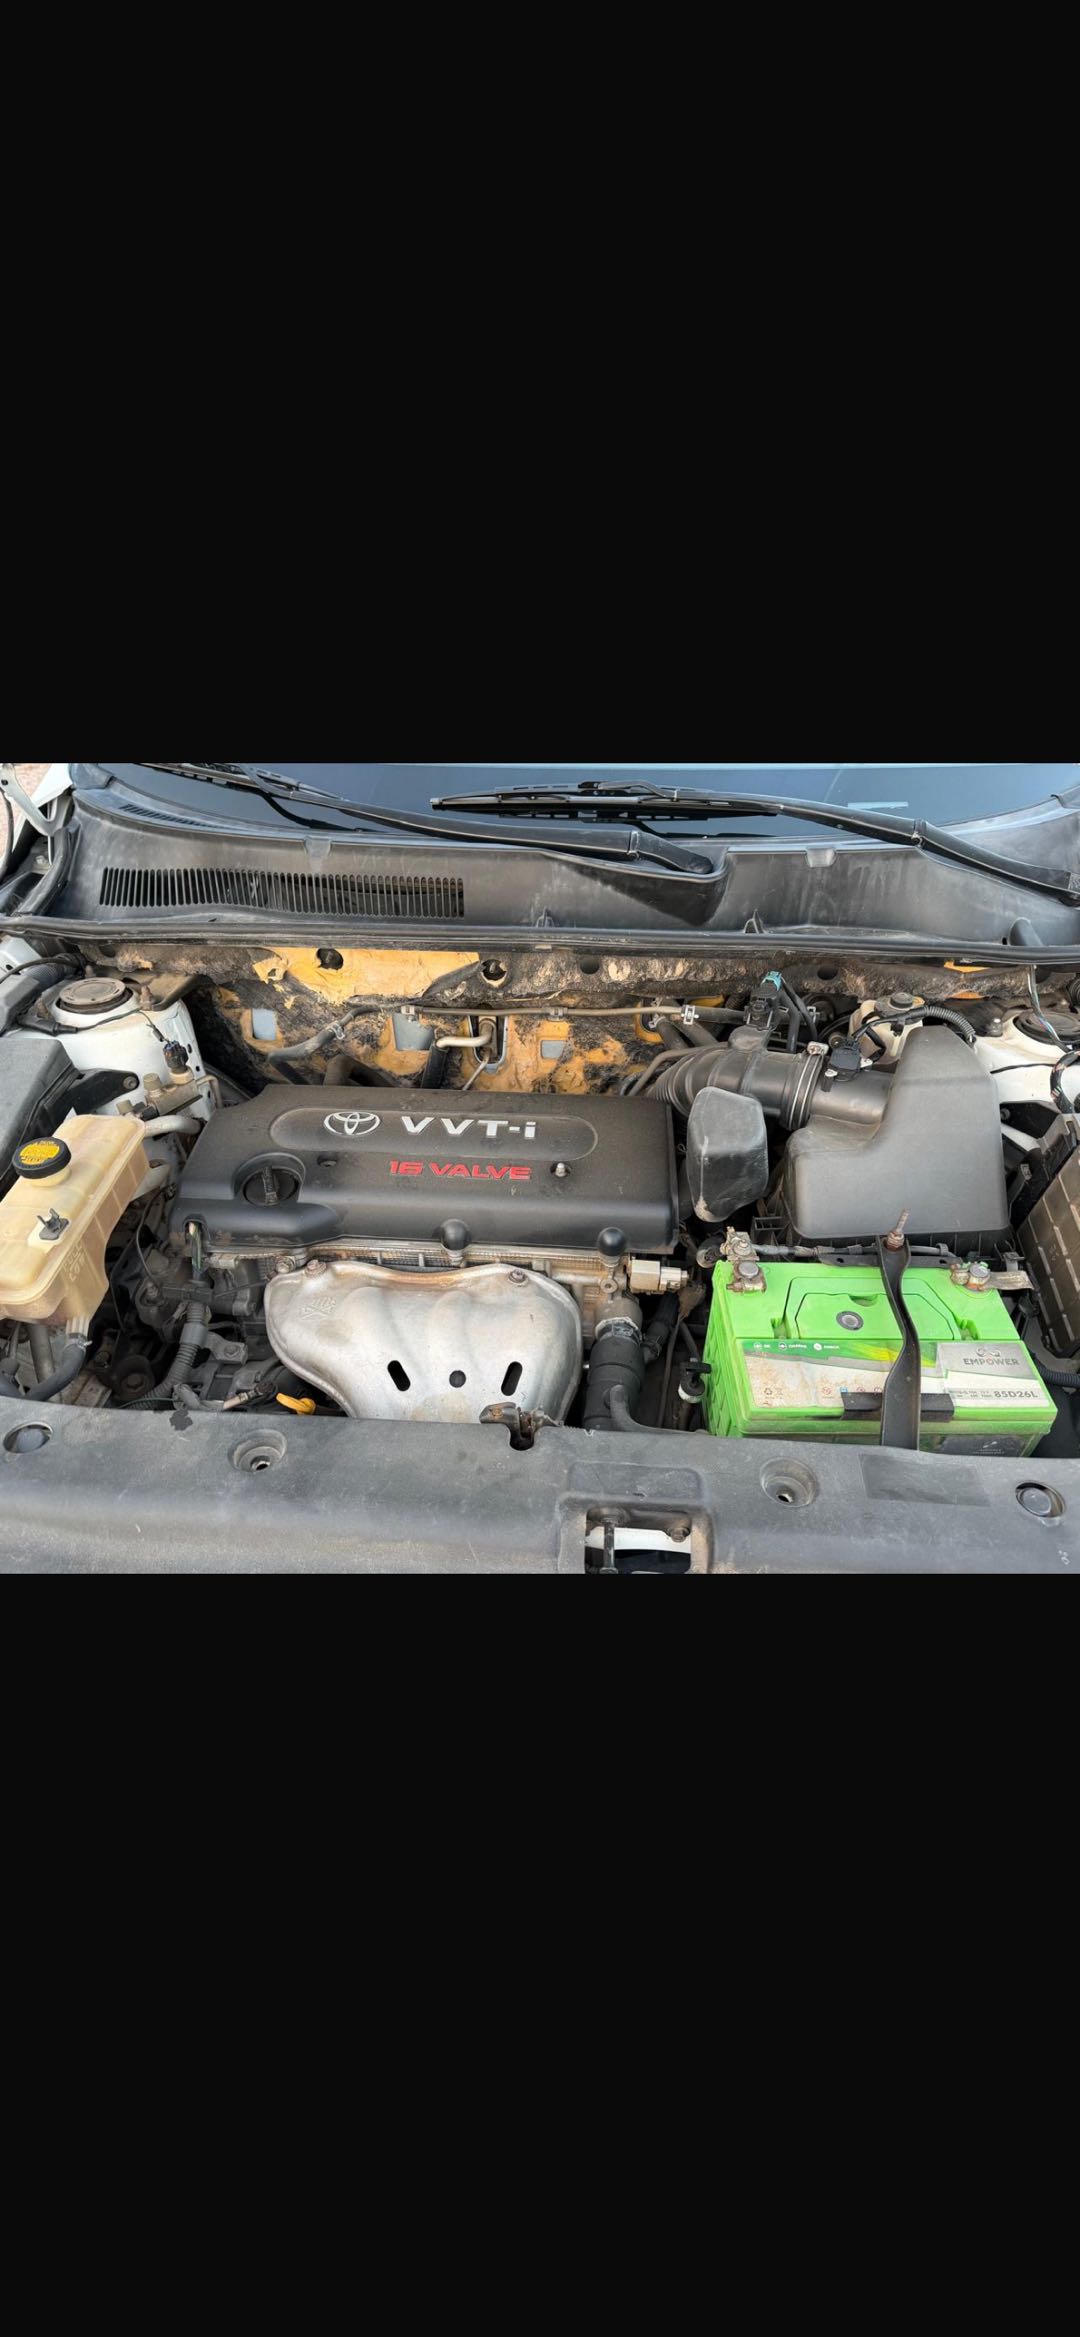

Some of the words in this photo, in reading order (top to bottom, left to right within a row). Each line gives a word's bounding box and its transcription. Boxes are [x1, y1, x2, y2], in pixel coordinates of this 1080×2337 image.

[401, 1115, 537, 1139] VVT-i
[389, 1160, 424, 1176] 16
[429, 1162, 531, 1180] VALVE
[963, 1358, 1020, 1366] EMPOWER
[994, 1390, 1038, 1398] 85D26L
